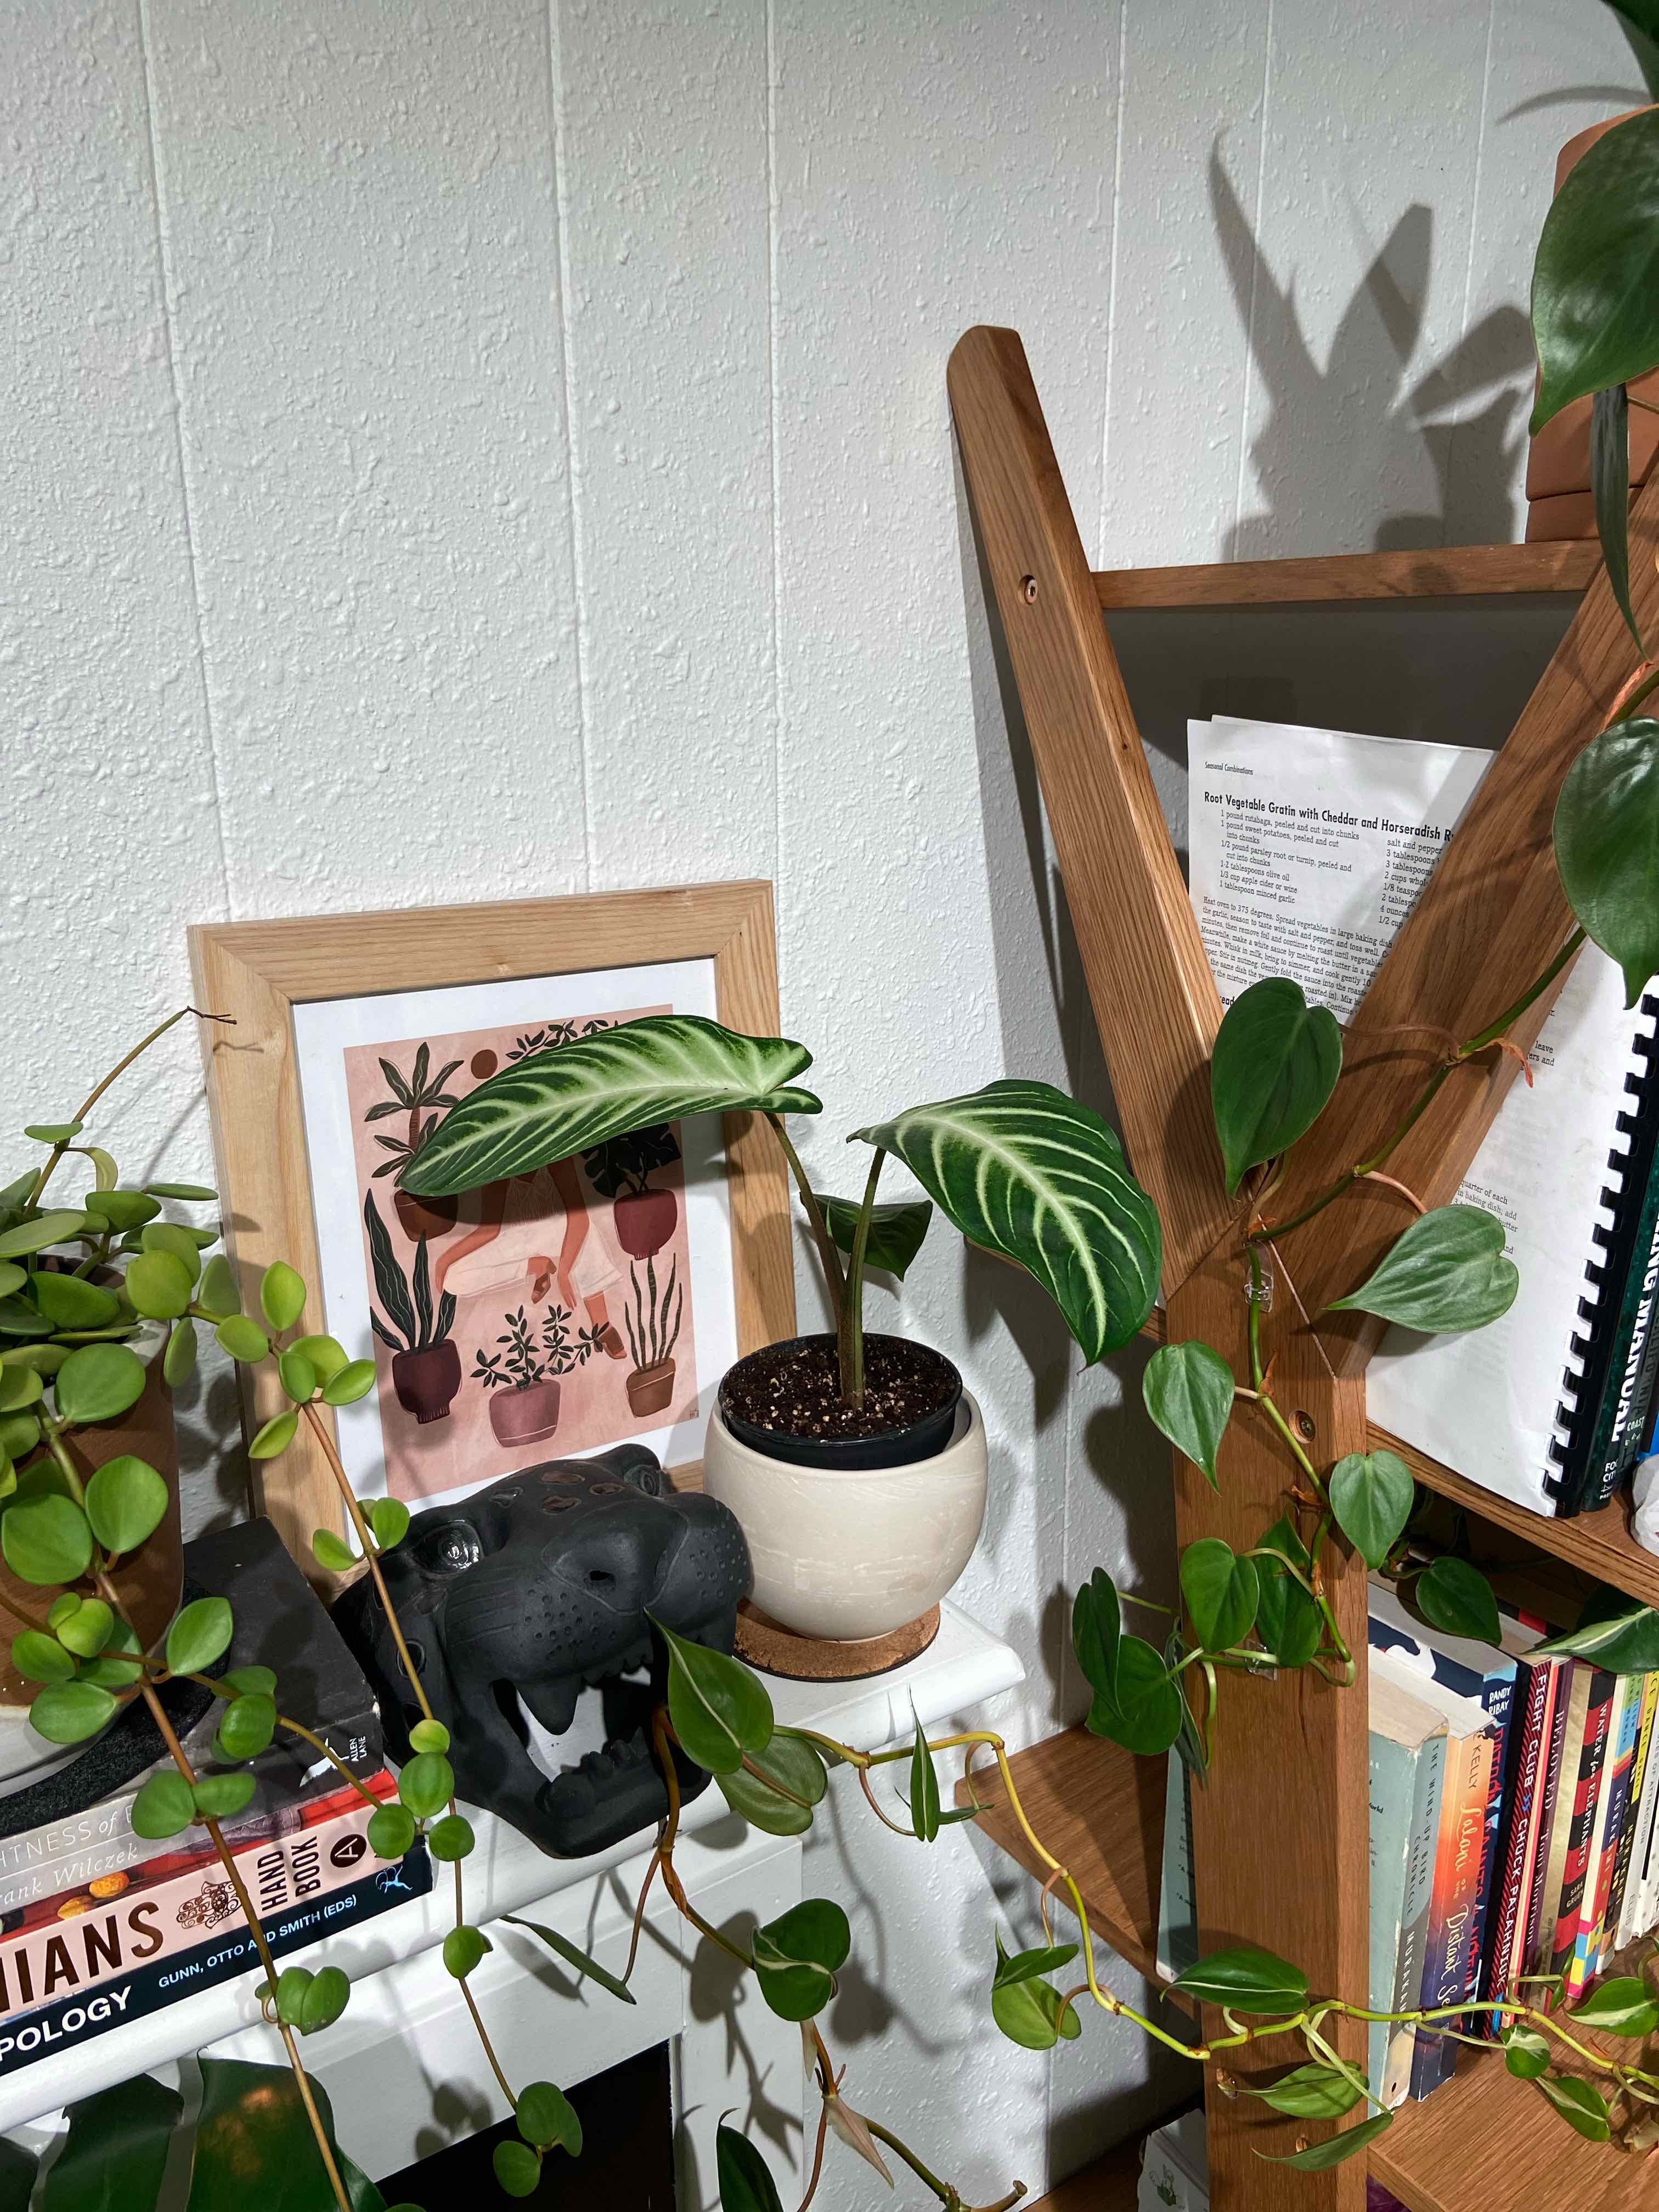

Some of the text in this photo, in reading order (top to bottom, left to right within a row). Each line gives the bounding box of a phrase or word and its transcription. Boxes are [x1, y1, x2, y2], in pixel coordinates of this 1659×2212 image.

[1205, 761, 1253, 775] Seasonal Combinations
[1205, 792, 1222, 804] Root
[1226, 794, 1265, 811] Vegetable
[1268, 802, 1296, 816] Gratin
[1299, 808, 1318, 820] with
[1322, 810, 1358, 826] Cheddar
[1362, 817, 1378, 829] and
[1381, 819, 1440, 839] Horseradish
[1226, 811, 1243, 820] pound
[1245, 815, 1272, 827] rutabaga,
[1275, 820, 1295, 830] peeled
[1297, 823, 1308, 832] and
[1322, 827, 1334, 836] into
[1336, 830, 1359, 840] chunks
[1226, 822, 1243, 831] pound
[1245, 825, 1262, 834] sweet
[1263, 829, 1291, 840] potatoes,
[1294, 834, 1313, 843] peeled
[1316, 837, 1327, 845] and
[1239, 834, 1260, 844] chunks
[1232, 842, 1249, 851] pound
[1250, 846, 1272, 858] parsley
[1296, 855, 1316, 866] turnip,
[1318, 860, 1338, 870] peeled
[1340, 864, 1352, 872] and
[1387, 838, 1401, 847] salt
[1418, 845, 1442, 854] pepper
[1393, 851, 1435, 865] tablespoons
[1231, 862, 1264, 876] tablespoons
[1266, 870, 1280, 878] olive
[1250, 856, 1271, 867] chunks
[1392, 862, 1433, 876] tablespoons
[1220, 870, 1228, 878] 1/3
[1230, 873, 1240, 882] cup
[1242, 876, 1257, 885] apple
[1260, 879, 1273, 888] cider
[1284, 885, 1297, 894] wine
[1383, 882, 1394, 891] 1/8
[1391, 873, 1407, 883] cups
[1409, 877, 1427, 886] whol
[1224, 882, 1255, 895] tablespoon
[1256, 889, 1277, 900] minced
[1278, 895, 1295, 904] garlic
[1378, 916, 1403, 929] 1/2 cup
[1386, 907, 1409, 917] ounces
[1212, 910, 1229, 918] garlic,
[1231, 915, 1249, 924] season
[1259, 921, 1272, 930] taste
[1274, 926, 1286, 934] with
[1300, 932, 1311, 940] and
[1313, 935, 1334, 946] pepper,
[1350, 944, 1362, 952] toss
[1364, 947, 1379, 956] well.
[1238, 905, 1249, 913] 375
[1251, 908, 1273, 919] degrees.
[1276, 914, 1295, 926] Spread
[1297, 920, 1328, 933] vegetables
[1338, 929, 1353, 939] large
[1356, 933, 1378, 946] baking
[1379, 939, 1392, 948] dish
[1535, 1041, 1553, 1053] leave
[1465, 1191, 1486, 1208] baking
[1505, 1211, 1517, 1220] add
[1492, 1193, 1508, 1205] each
[1611, 1296, 1652, 1442] MANUAL
[1627, 1415, 1645, 1431] COAST
[1489, 1685, 1512, 1704] RANDY
[1488, 1700, 1510, 1716] RIBAY
[349, 1737, 359, 1761] ALLEN
[358, 1736, 367, 1758] LANE
[1468, 1744, 1482, 1789] KELLY
[1577, 1703, 1608, 1867] WATER for ELEPHANTS
[99, 1811, 118, 1836] of
[1419, 1743, 1440, 1884] THE WIND-UP BIRD
[1455, 1803, 1482, 1872] Lalani
[1497, 1674, 1547, 1988] FIGHT CLUB CHUCK PALAHNIUK
[1527, 1710, 1564, 1945] BELOVED Toni Morrison
[1605, 1789, 1623, 1872] MURAKAMI
[53, 1842, 138, 1887] Wilczek
[257, 1836, 321, 1911] HAND BOOK
[1407, 1836, 1420, 1916] CHRONICLE
[1570, 1881, 1583, 1898] SARA
[159, 1962, 204, 1988] GUNN,
[207, 1944, 244, 1967] OTTO
[279, 1911, 320, 1937] SMITH
[324, 1894, 357, 1918] (EDS)
[1441, 1904, 1469, 1980] Distant
[1437, 1984, 1458, 2006] Se
